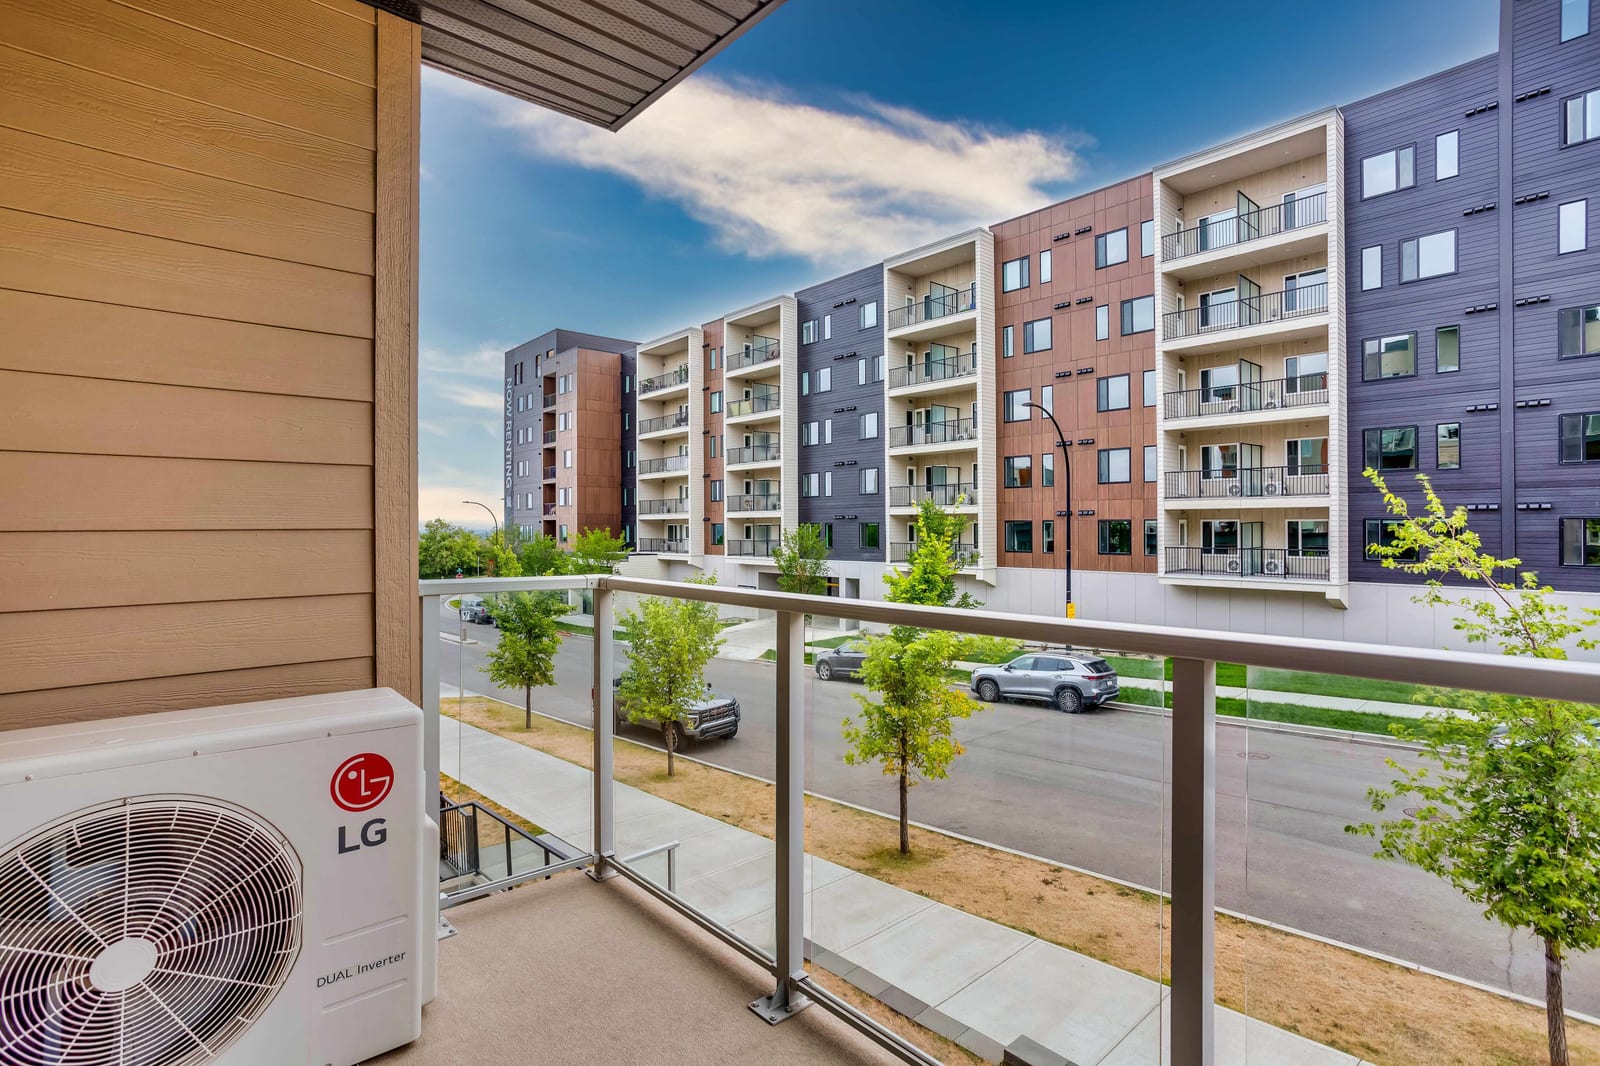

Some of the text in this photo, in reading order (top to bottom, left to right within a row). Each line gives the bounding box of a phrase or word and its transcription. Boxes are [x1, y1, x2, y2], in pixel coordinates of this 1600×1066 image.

[338, 817, 387, 855] LG
[316, 951, 407, 988] DUAL Inverter
